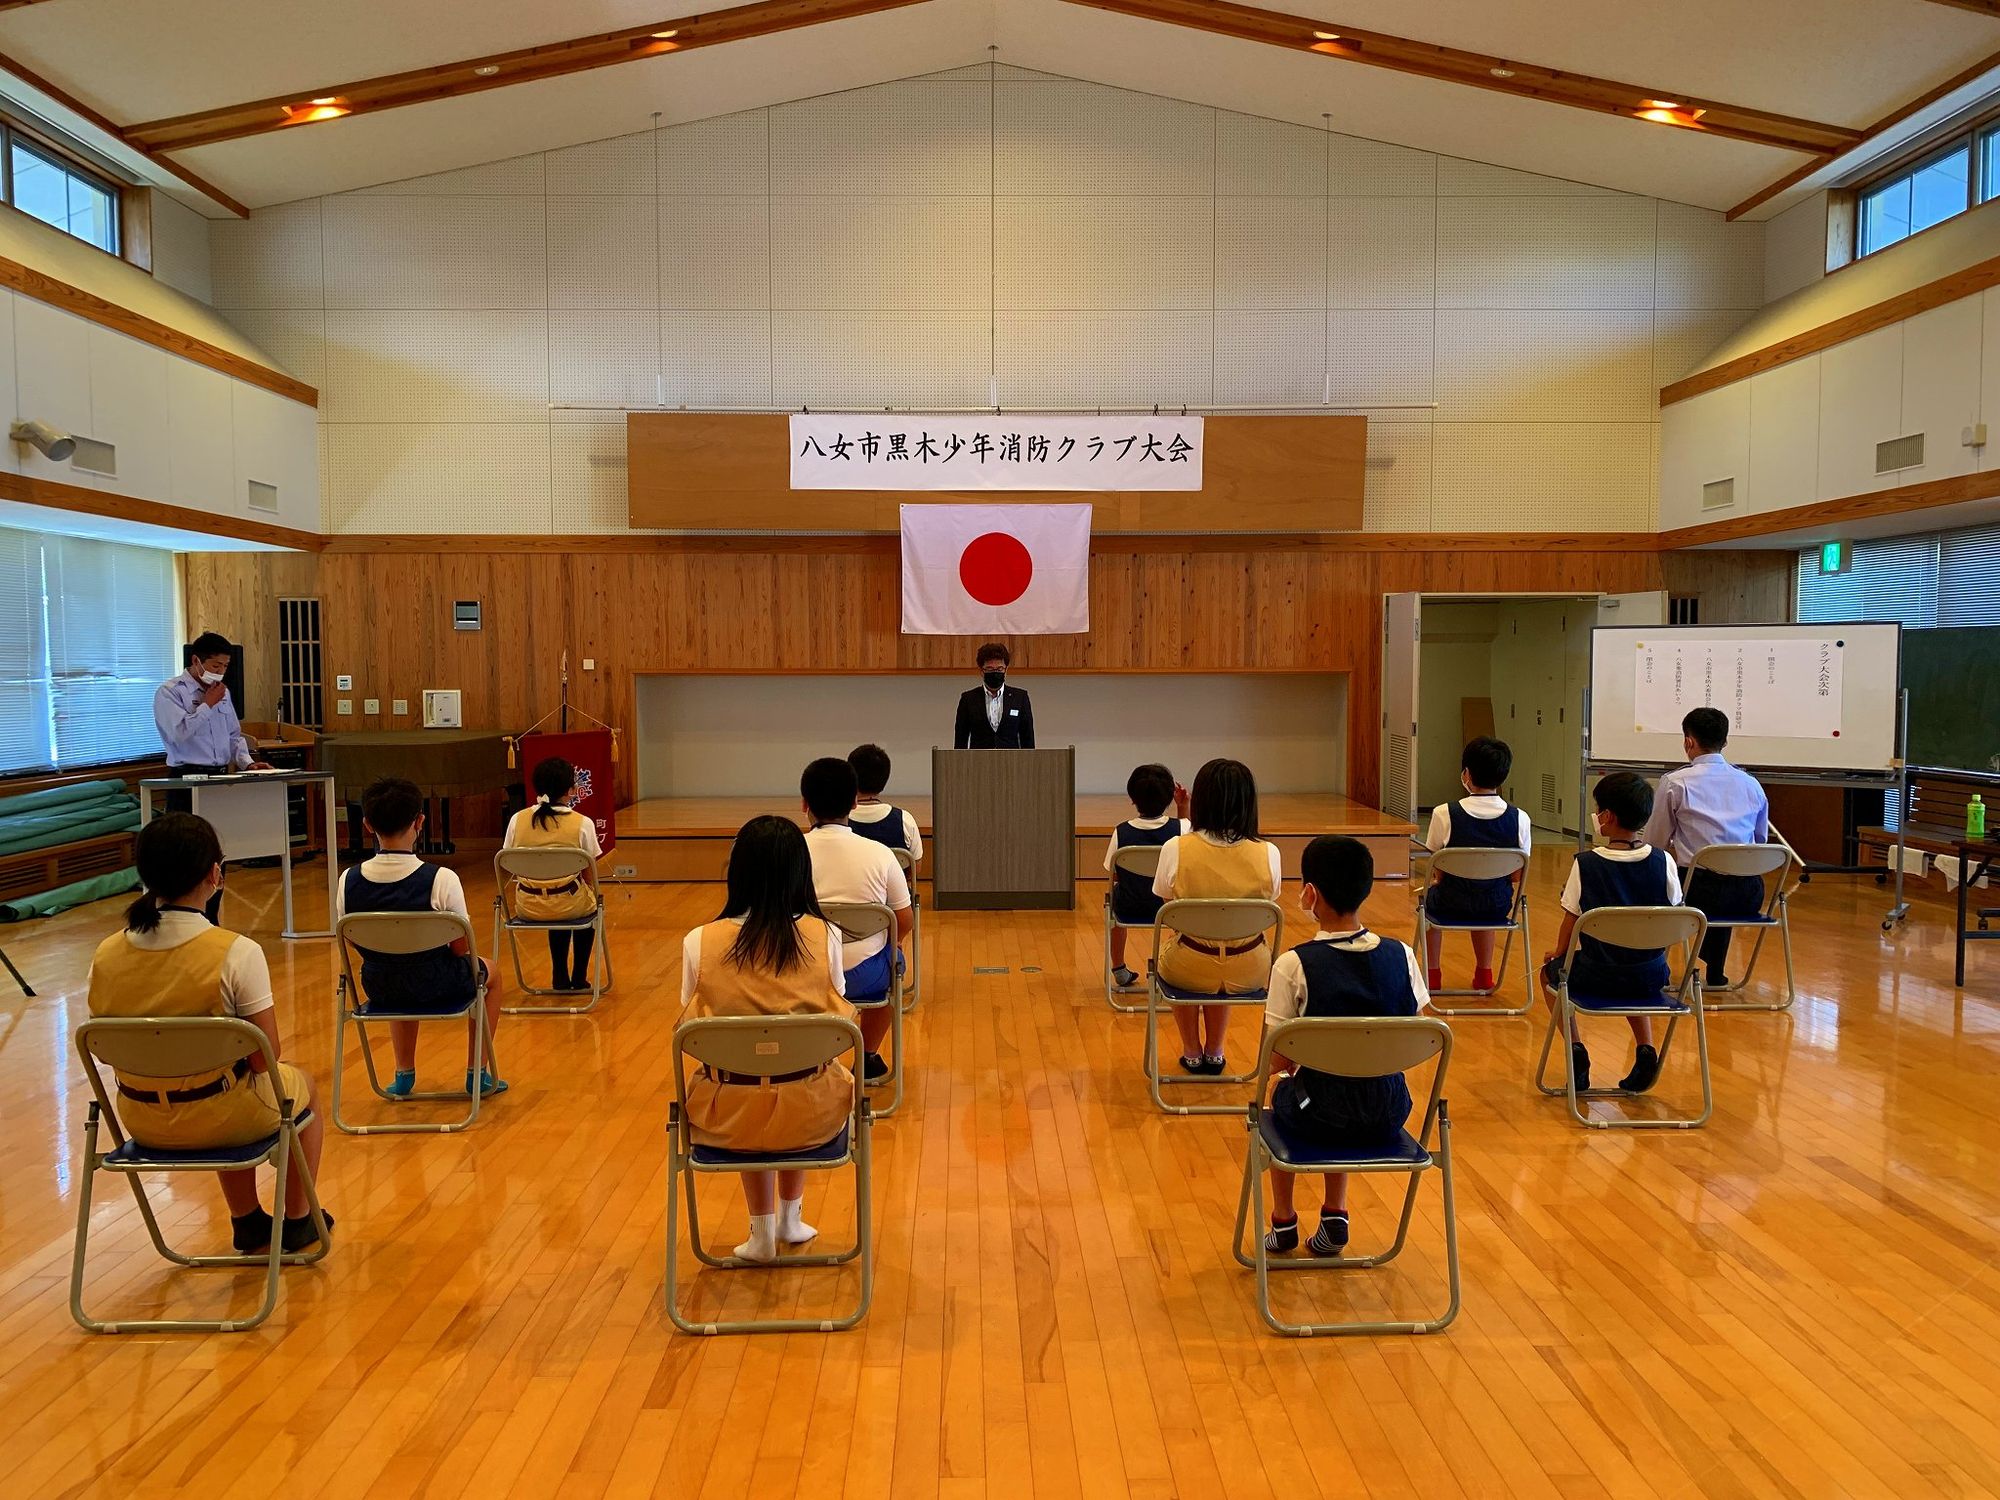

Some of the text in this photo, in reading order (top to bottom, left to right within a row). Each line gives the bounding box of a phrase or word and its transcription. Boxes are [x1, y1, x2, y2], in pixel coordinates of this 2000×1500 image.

[800, 431, 1194, 465] 八女市黒木少年消防クラブ大会
[1818, 643, 1831, 697] クラブ大会次第
